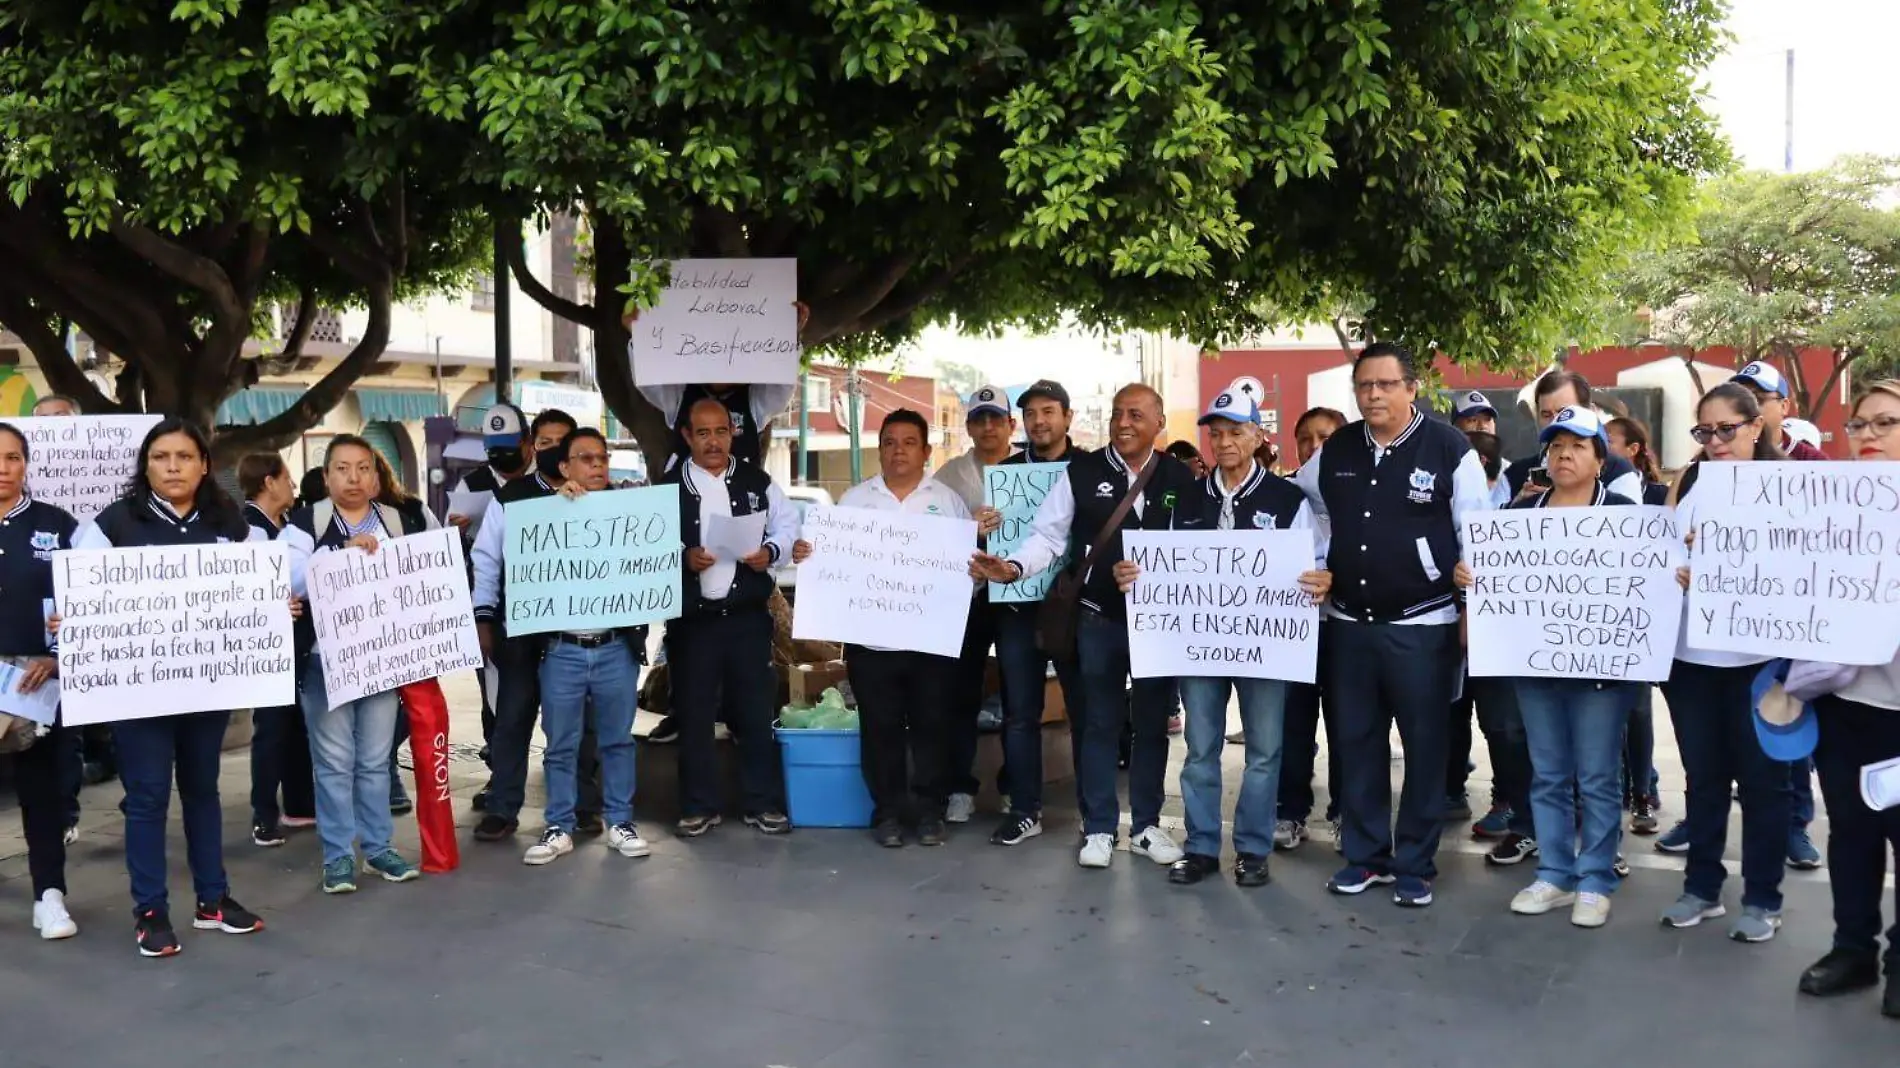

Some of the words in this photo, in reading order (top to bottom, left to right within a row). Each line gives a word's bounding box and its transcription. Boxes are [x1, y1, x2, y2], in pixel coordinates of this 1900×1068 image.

[688, 295, 768, 316] Laboral
[62, 422, 78, 442] al
[86, 421, 132, 446] pliego
[47, 444, 121, 464] presentado
[38, 466, 88, 479] Morelos
[54, 482, 76, 497] del
[1731, 465, 1900, 519] Exigimos
[519, 511, 667, 555] MAESTRO
[879, 523, 919, 545] pliego
[1469, 512, 1679, 545] BASIFICACIÓN
[1700, 519, 1758, 569] Pago
[1767, 513, 1884, 556] inmediato
[65, 552, 187, 589] Estabilidad
[197, 548, 257, 577] laboral
[311, 546, 390, 604] Igualdad
[394, 532, 455, 576] laboral
[511, 557, 610, 584] LUCHANDO
[1131, 545, 1268, 578] MAESTRO
[1472, 544, 1668, 570] HOMOLOGACIÓN
[1132, 581, 1248, 607] LUCHANDO
[1474, 573, 1646, 600] RECONOCER
[1697, 564, 1785, 597] adeudos
[1794, 560, 1817, 598] al
[64, 588, 177, 620] basificación
[185, 580, 246, 614] urgente
[252, 586, 265, 601] a
[271, 578, 291, 601] los
[332, 602, 365, 640] pago
[368, 592, 388, 618] de
[392, 584, 414, 612] 90
[511, 595, 556, 622] ESTA
[566, 584, 674, 617] LUCHANDO
[1477, 597, 1651, 631] ANTIGÜEDAD
[62, 615, 166, 652] agremiados
[172, 610, 188, 634] al
[194, 606, 269, 632] sindicato
[337, 621, 408, 670] aguinaldo
[408, 612, 472, 641] conforme
[1134, 612, 1182, 633] ESTA
[1193, 613, 1310, 642] ENSEÑANDO
[1543, 622, 1652, 655] STODEM
[62, 650, 95, 674] que
[101, 640, 145, 662] hasta
[151, 638, 167, 658] la
[171, 635, 215, 658] fecha
[222, 633, 244, 653] ha
[247, 631, 283, 651] sido
[363, 655, 383, 679] del
[385, 646, 427, 672] servicio
[429, 632, 460, 658] civil
[1185, 644, 1263, 665] STODEM
[1527, 649, 1641, 677] CONALEP
[62, 667, 119, 694] negada
[126, 664, 145, 686] de
[151, 660, 194, 683] forma
[199, 652, 292, 684] injustificada
[382, 669, 418, 691] estado
[418, 664, 433, 680] de
[434, 653, 482, 678] Morelos
